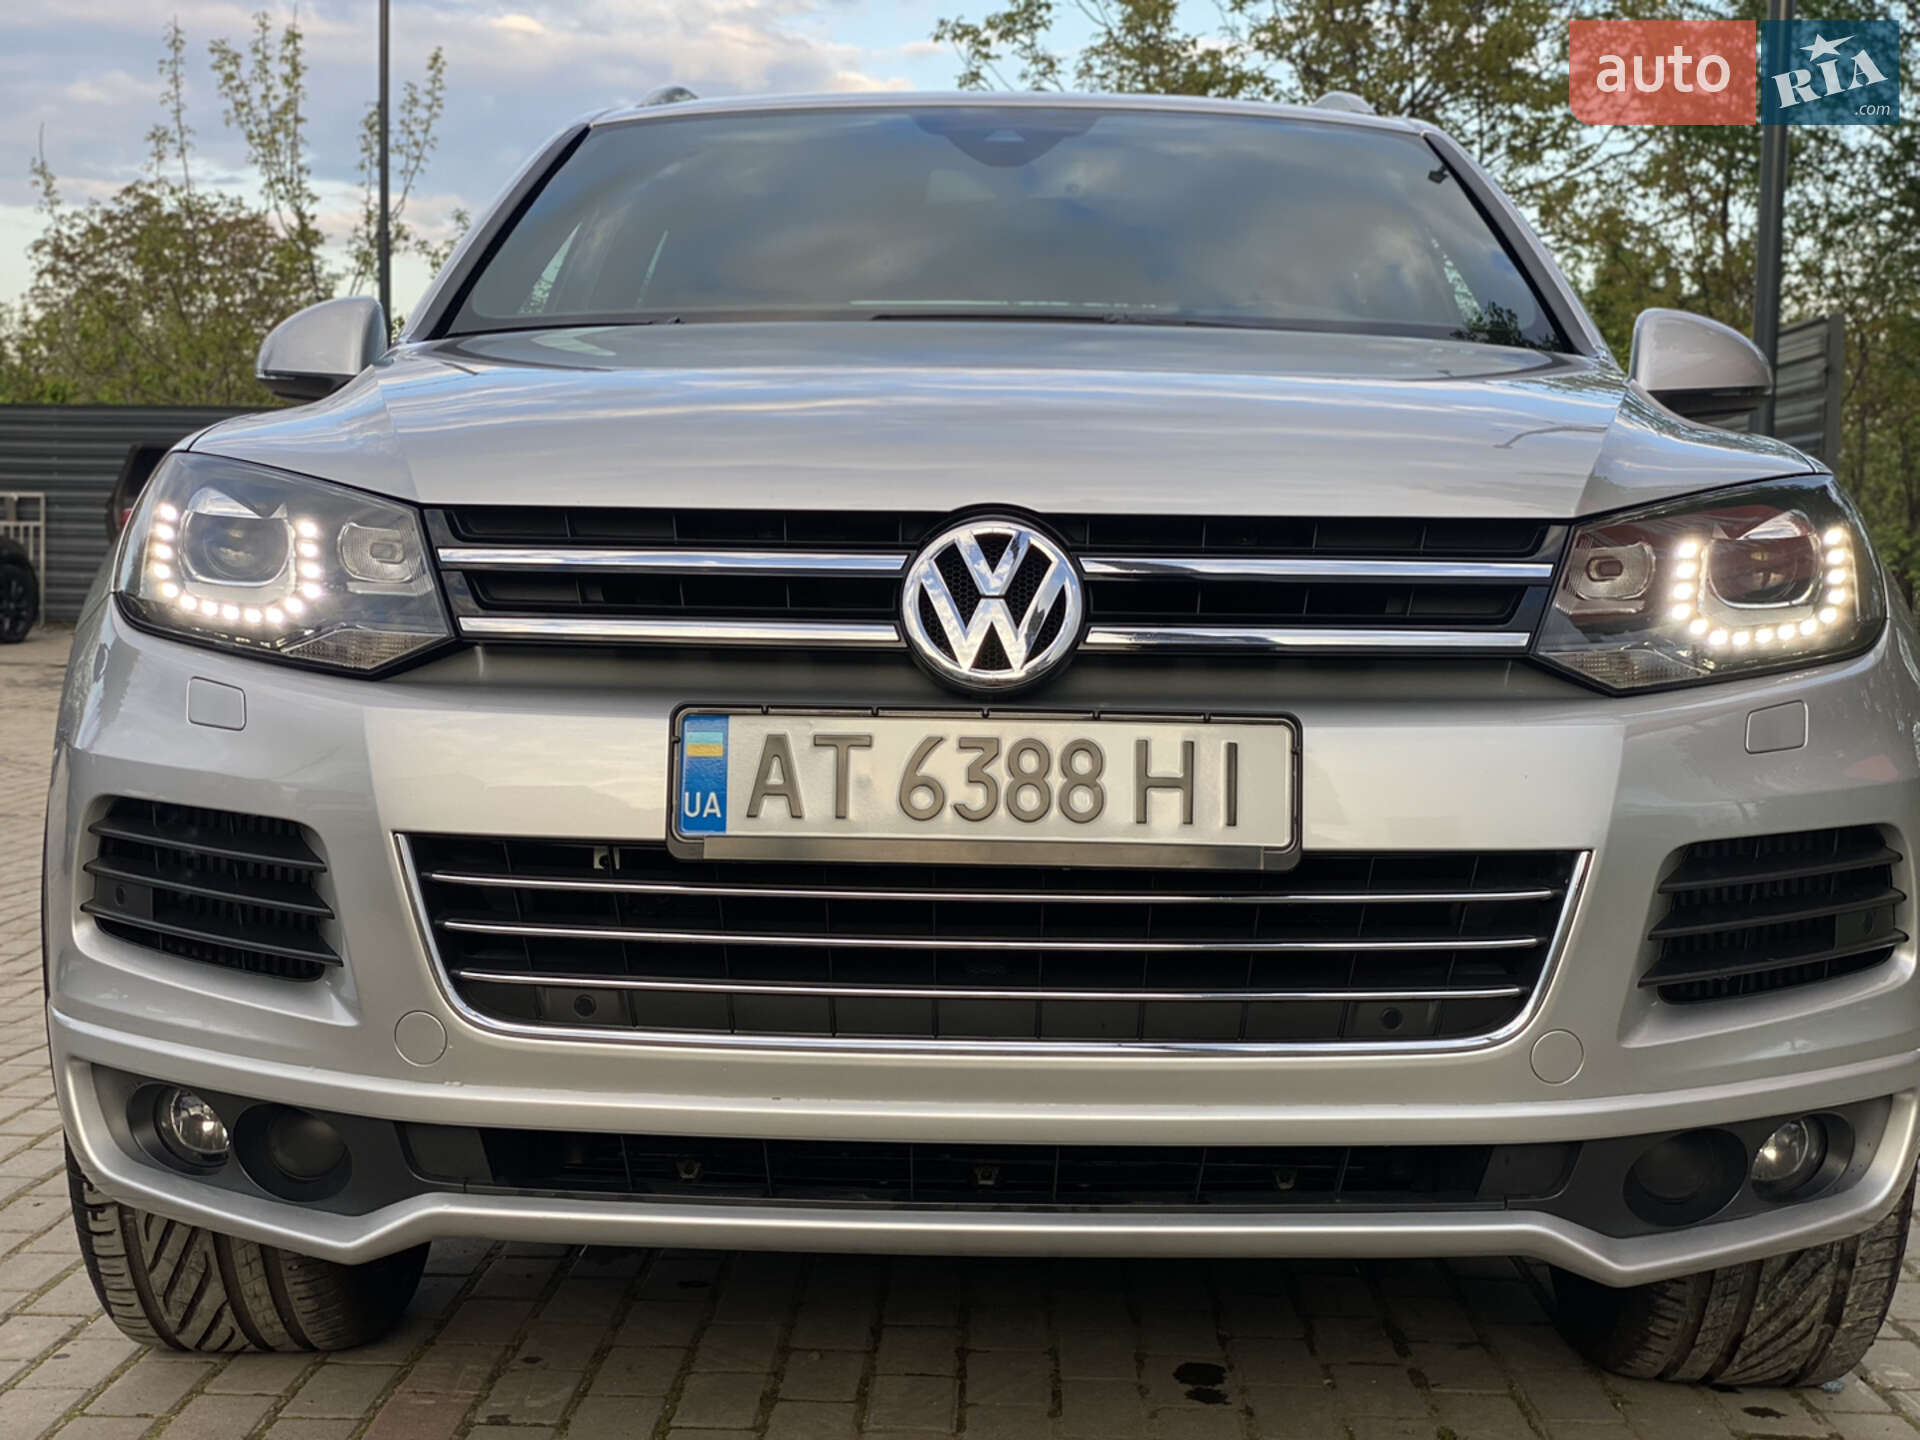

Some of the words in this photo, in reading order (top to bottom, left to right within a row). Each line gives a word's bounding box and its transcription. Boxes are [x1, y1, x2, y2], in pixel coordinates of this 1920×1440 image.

[684, 792, 722, 819] UA
[746, 733, 874, 820] AT
[897, 736, 1107, 824] 6388
[1135, 738, 1239, 828] HI
